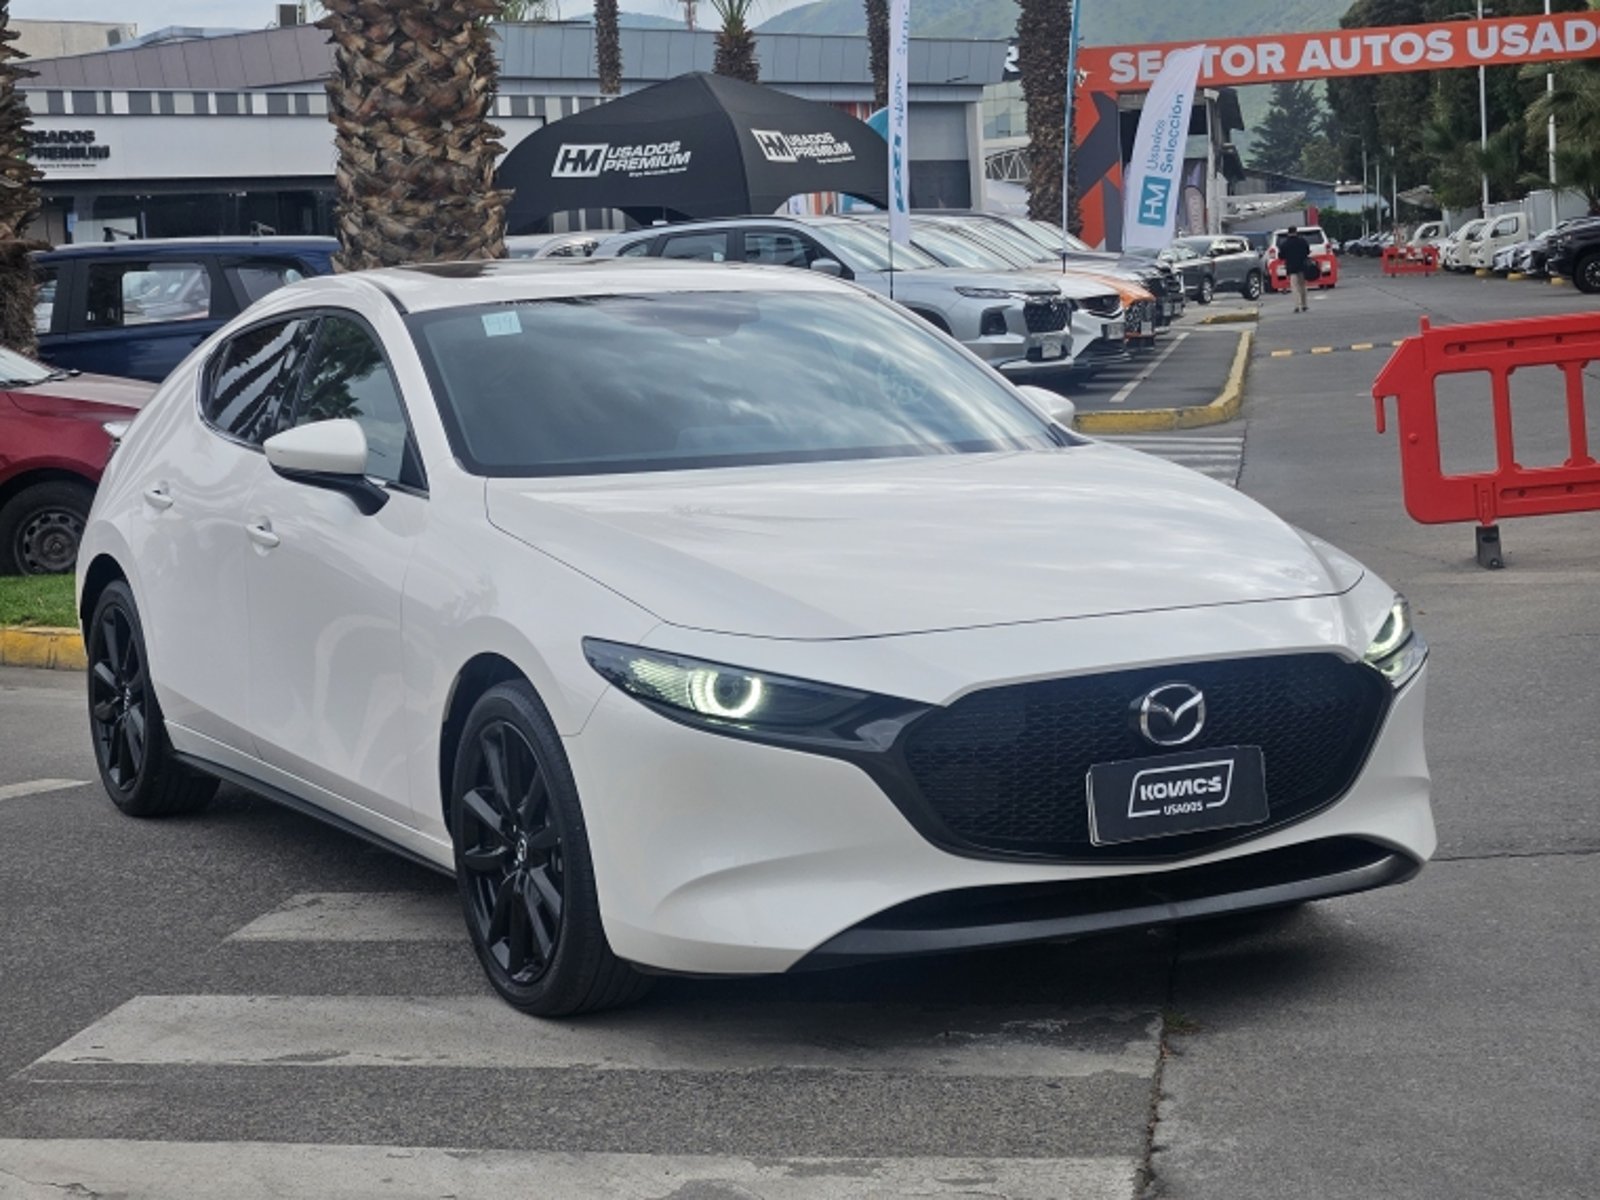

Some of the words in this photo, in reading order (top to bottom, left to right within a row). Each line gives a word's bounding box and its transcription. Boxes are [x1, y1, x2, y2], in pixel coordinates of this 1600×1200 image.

[1109, 43, 1285, 84] SETOR
[1298, 29, 1454, 73] AUTOS
[1466, 19, 1600, 59] USAD
[1147, 119, 1166, 171] Usados
[1160, 93, 1184, 174] Selección
[556, 145, 604, 176] HM
[603, 151, 691, 171] PREMIUM
[607, 141, 681, 159] USADOS
[1142, 181, 1167, 220] HM
[1140, 776, 1222, 801] KOVACS
[1163, 801, 1204, 815] USADOS
